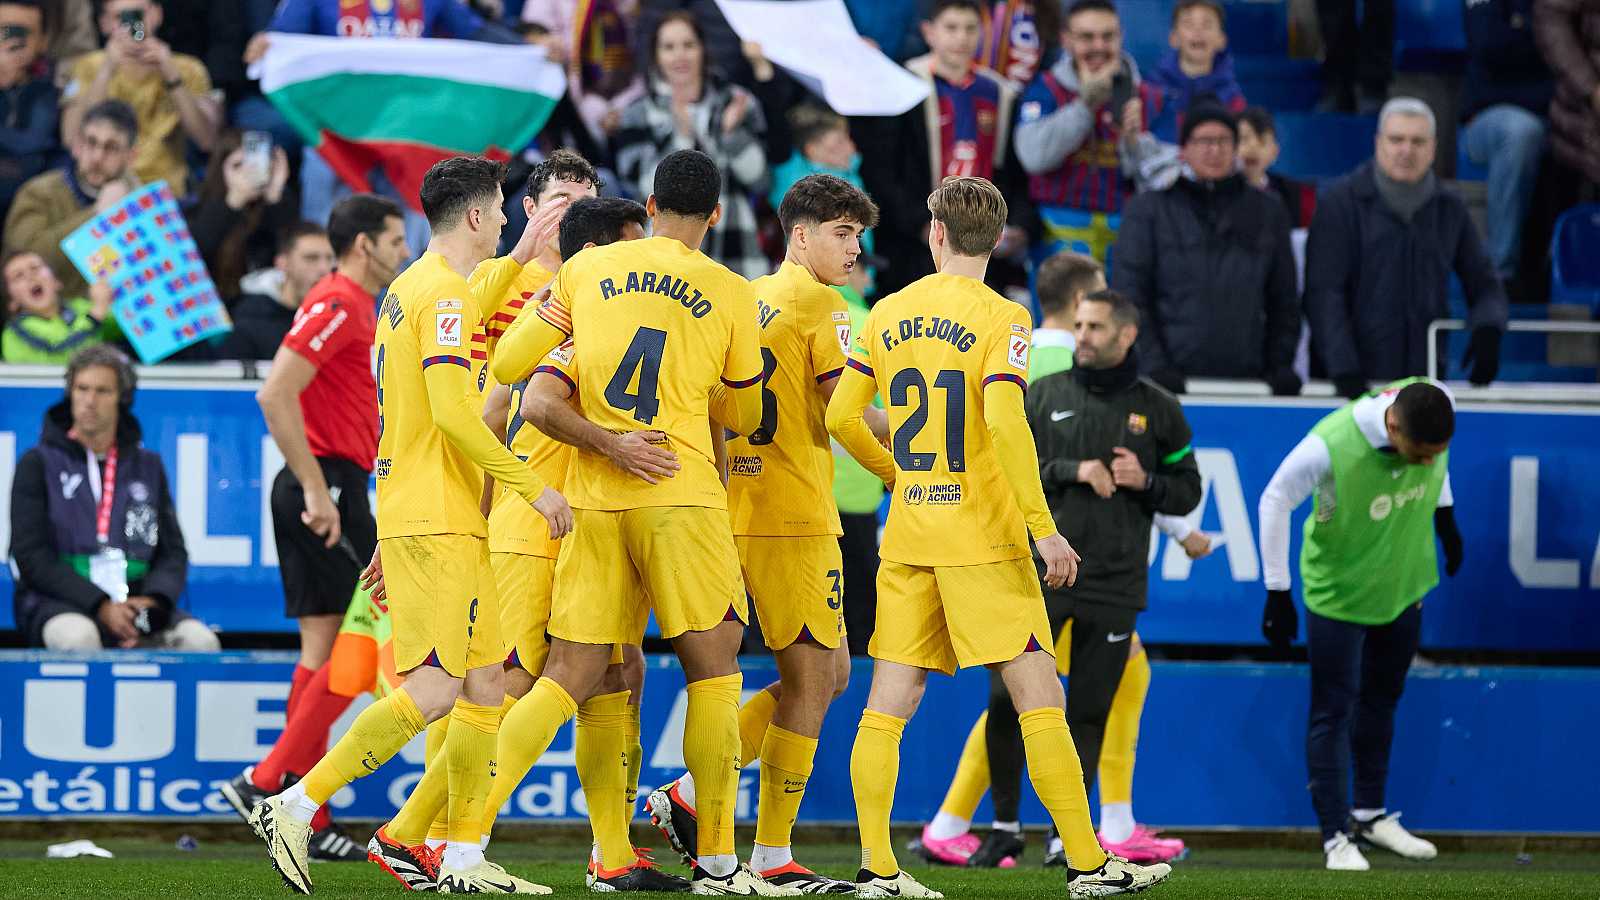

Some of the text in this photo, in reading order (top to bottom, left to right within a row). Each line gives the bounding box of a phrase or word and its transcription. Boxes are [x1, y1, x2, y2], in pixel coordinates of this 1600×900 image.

[599, 271, 712, 318] R. ARAUJO
[881, 316, 977, 352] F. DE JONG
[603, 325, 668, 426] 4
[889, 367, 966, 473] 21
[927, 493, 962, 502] ACNUR
[928, 484, 961, 493] UNHCR
[826, 569, 841, 610] 3
